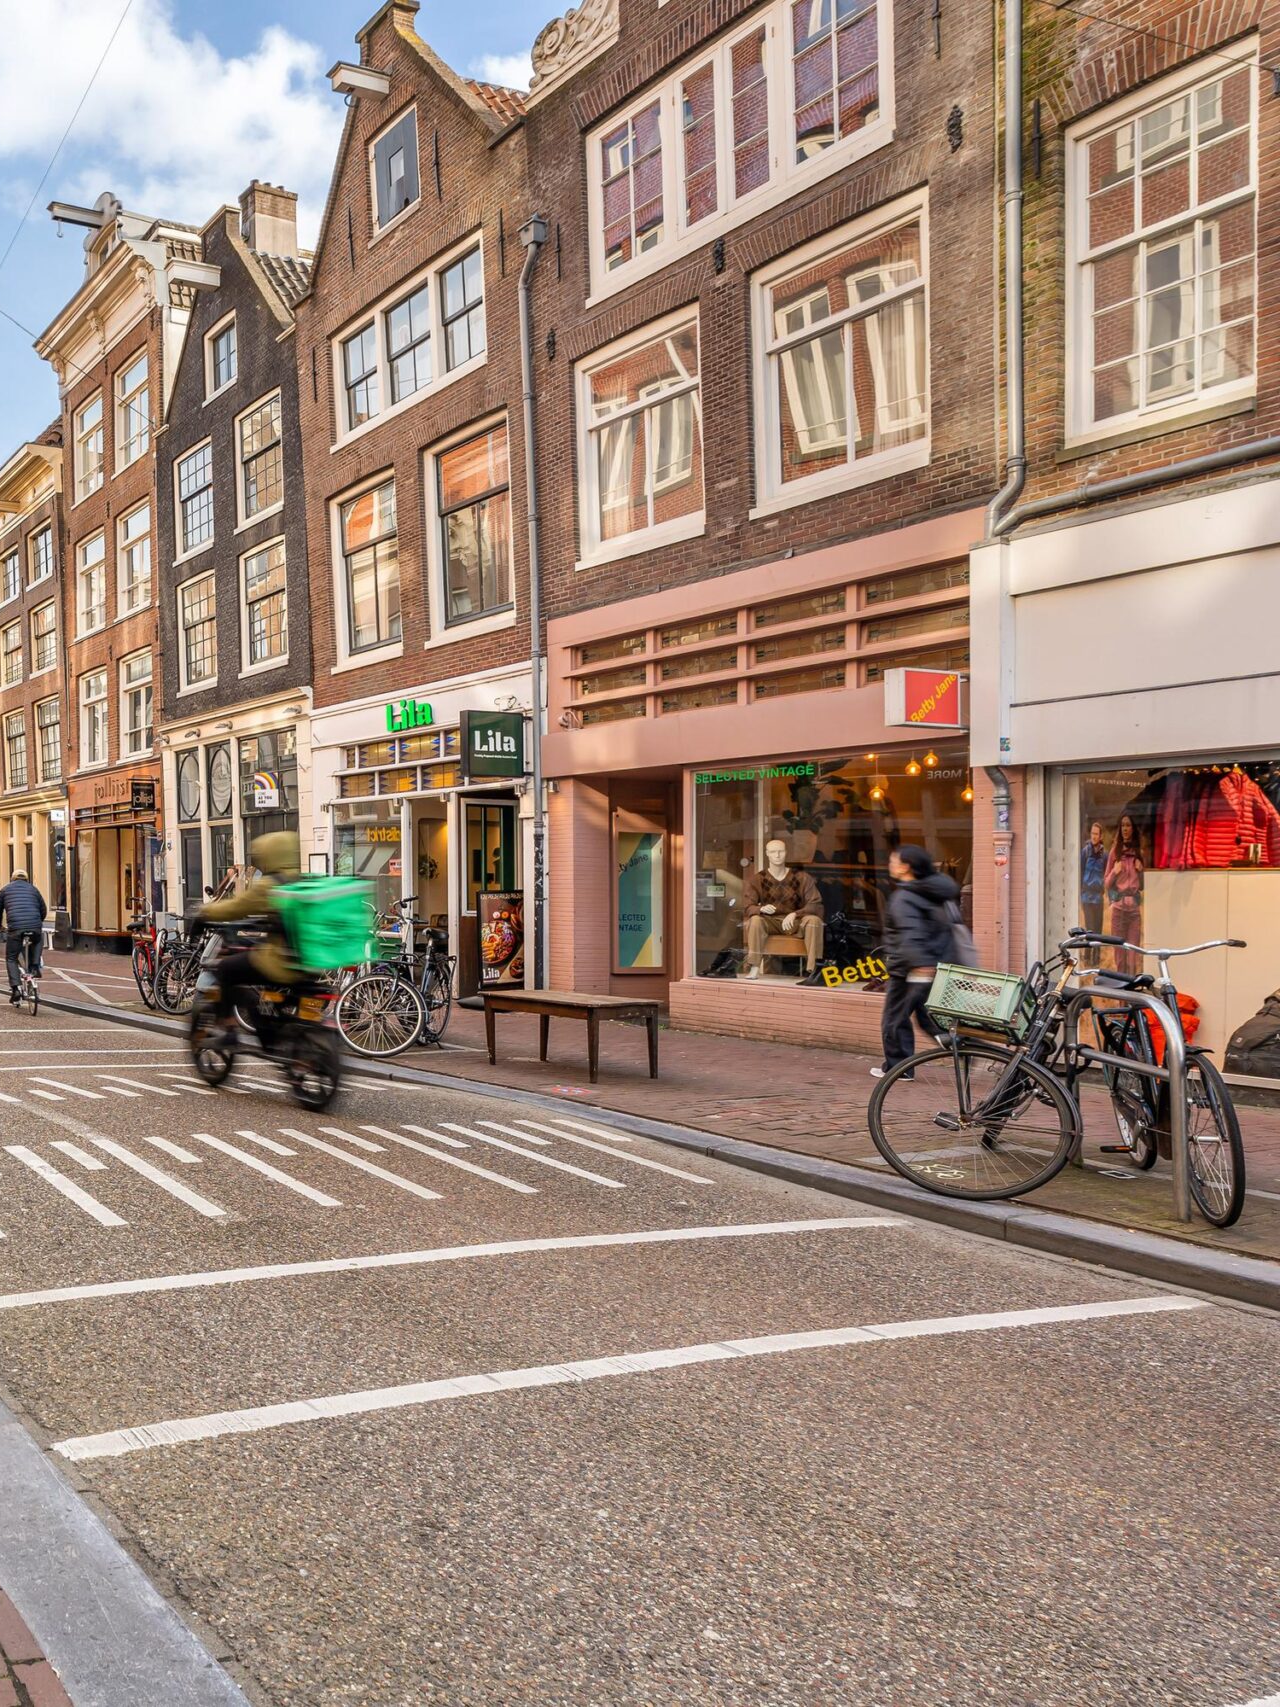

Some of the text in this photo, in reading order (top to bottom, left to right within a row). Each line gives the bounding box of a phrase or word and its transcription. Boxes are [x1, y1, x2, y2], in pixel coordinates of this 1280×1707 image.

[385, 699, 434, 733] Lila
[910, 695, 936, 723] Betty
[474, 729, 517, 752] Lila
[695, 764, 815, 784] SELECTED VINTAGE
[482, 967, 500, 980] Lila
[821, 955, 890, 988] Betty
